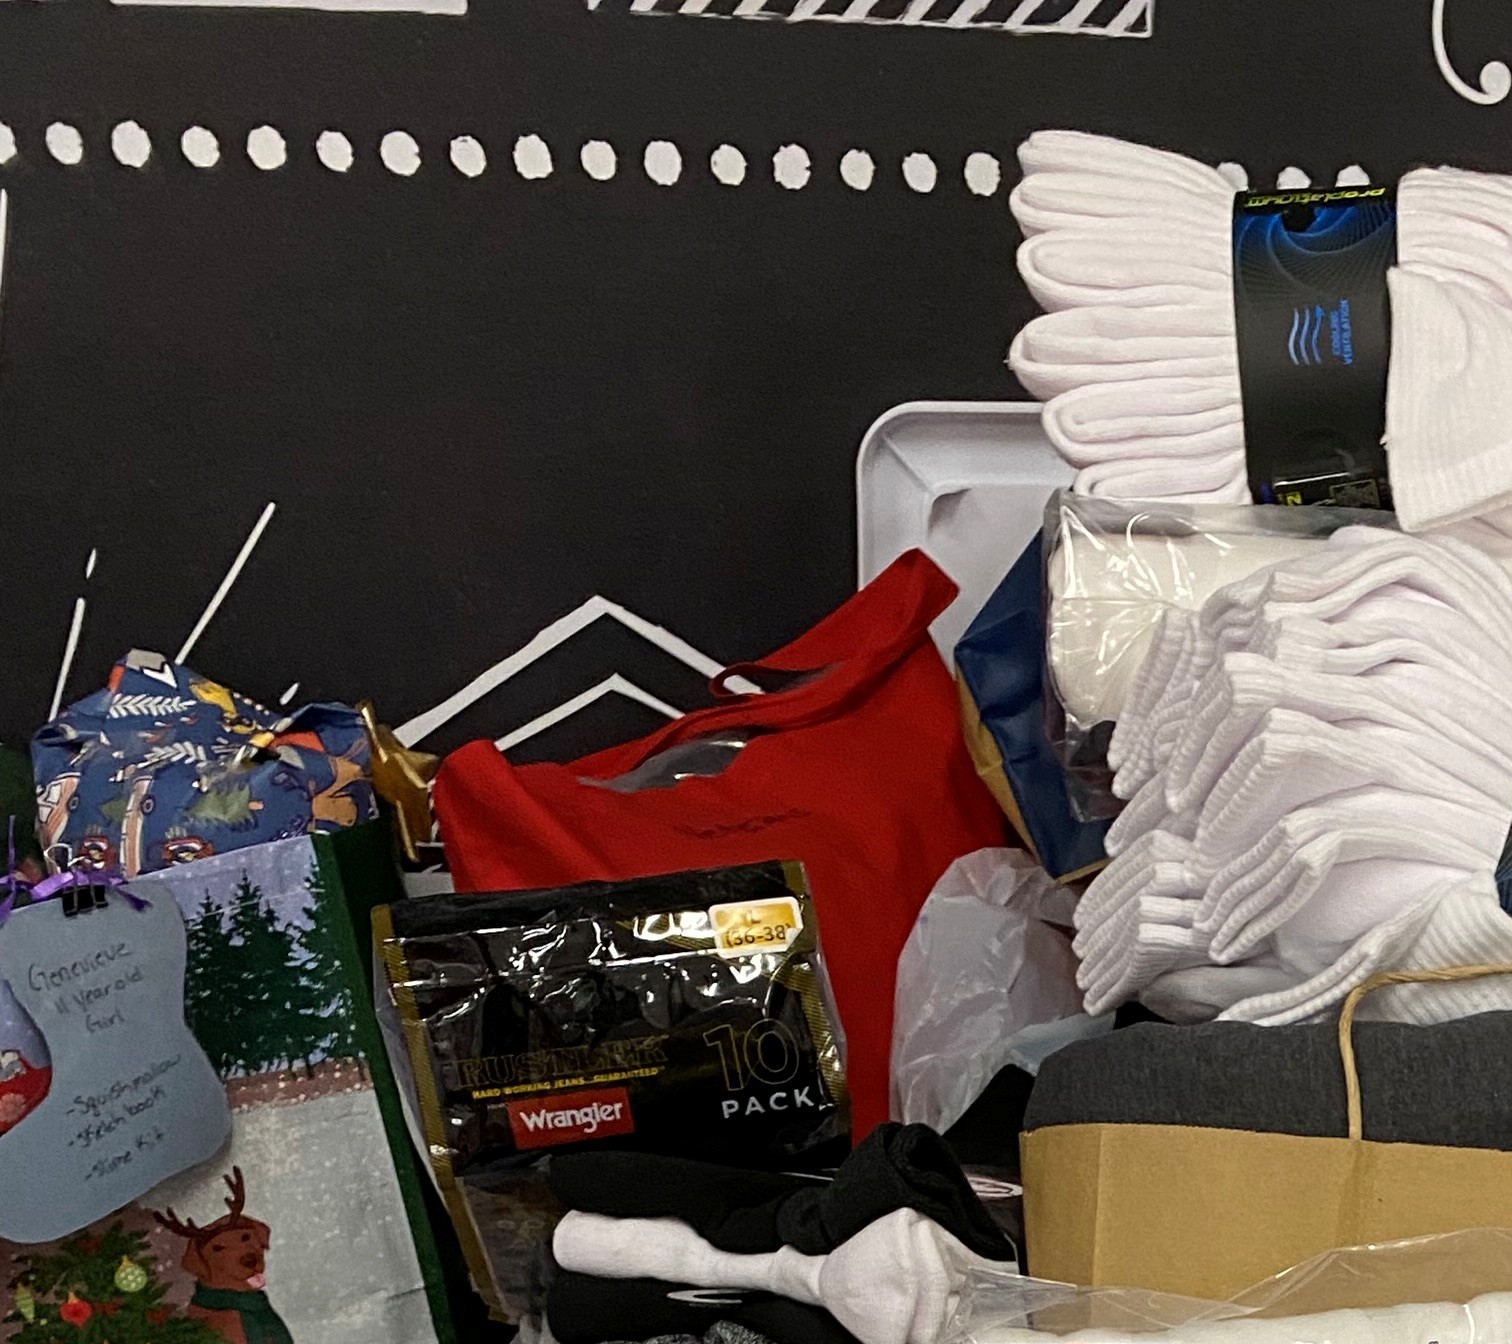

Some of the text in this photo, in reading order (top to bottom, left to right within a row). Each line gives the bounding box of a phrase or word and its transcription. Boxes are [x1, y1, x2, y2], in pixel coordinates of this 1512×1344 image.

[28, 942, 132, 992] Genevieve
[115, 966, 144, 989] old
[703, 1018, 799, 1092] 10
[472, 1088, 500, 1099] HARD
[503, 1081, 551, 1095] WORKING
[721, 1085, 815, 1119] PACK
[519, 1101, 623, 1133] Wrangler
